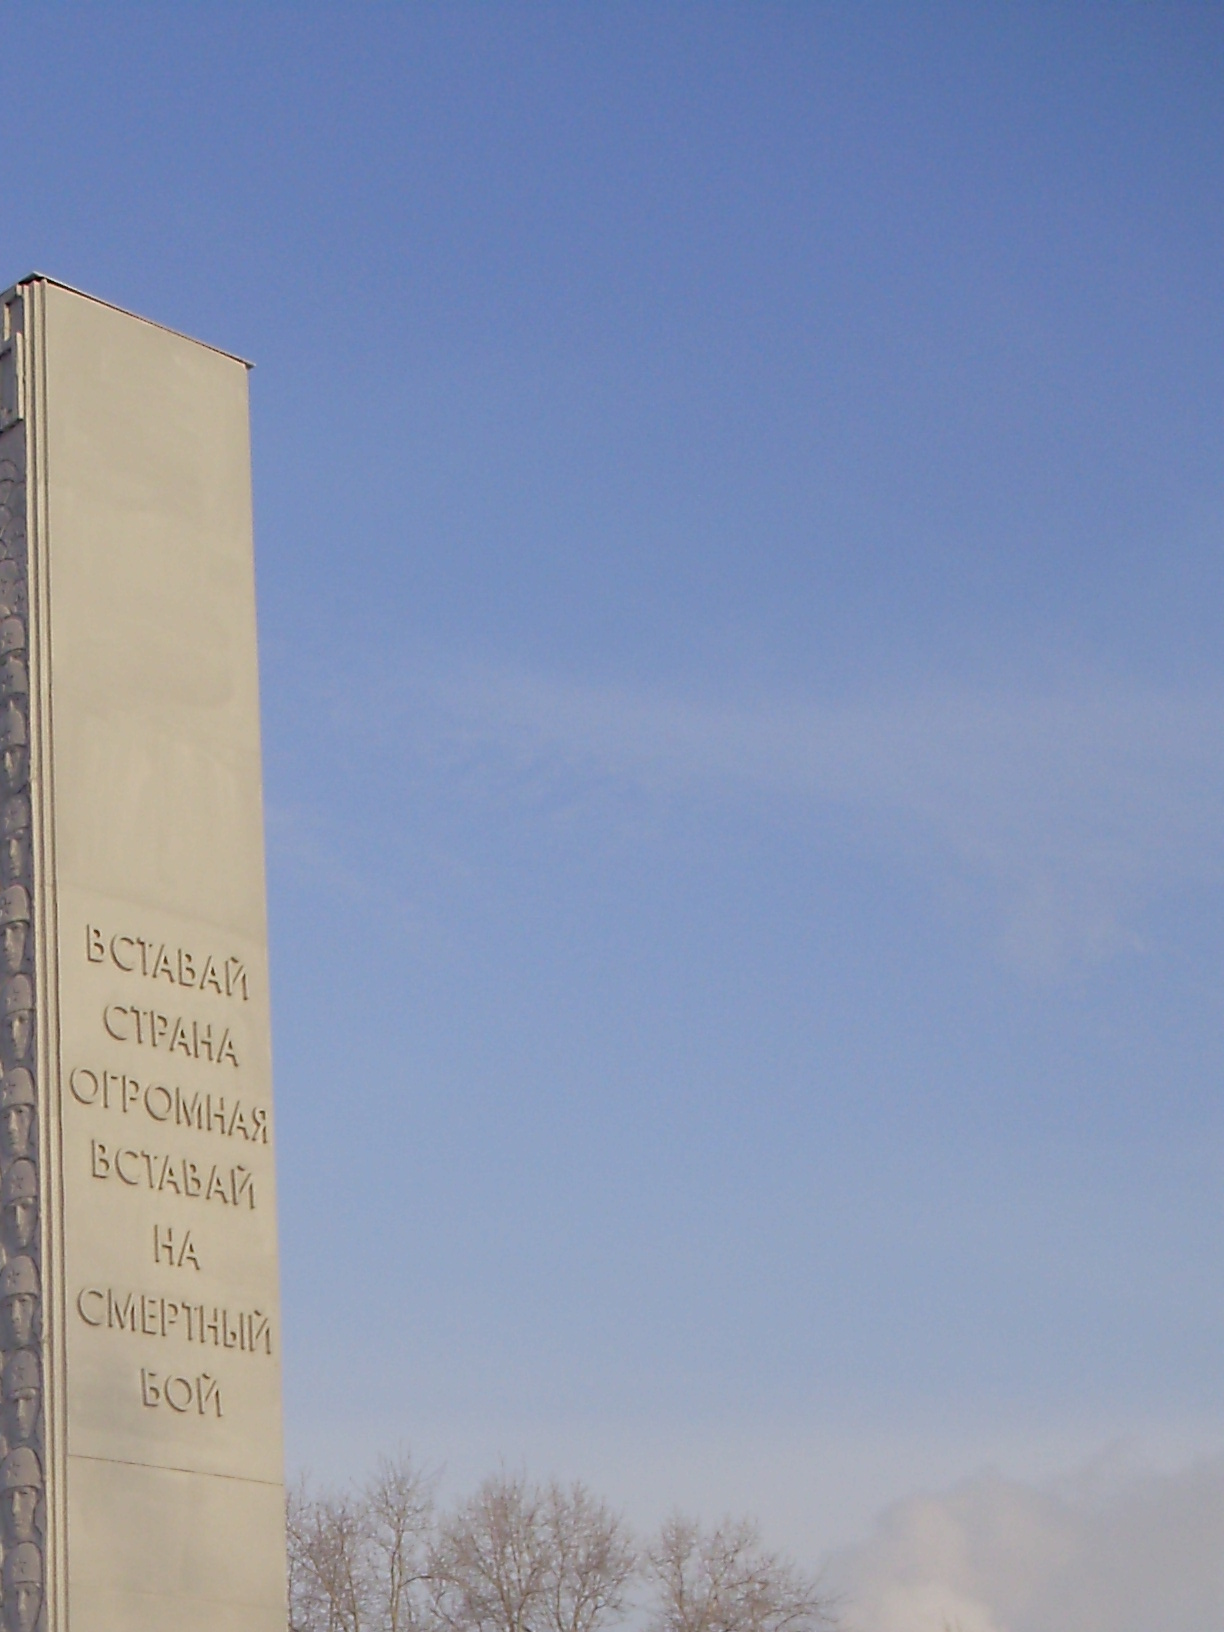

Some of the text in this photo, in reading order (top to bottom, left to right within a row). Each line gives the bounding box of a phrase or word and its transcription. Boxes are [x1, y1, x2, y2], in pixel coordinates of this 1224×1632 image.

[86, 923, 250, 1001] ВСТАВАЙ
[103, 1003, 239, 1067] СТРАНА
[69, 1066, 269, 1145] ОГРОМНАЯ
[91, 1138, 256, 1210] ВСТАВАЙ
[153, 1224, 201, 1271] НА
[77, 1287, 273, 1355] СМЕРТНЫЙ
[140, 1367, 224, 1418] БОЙ
